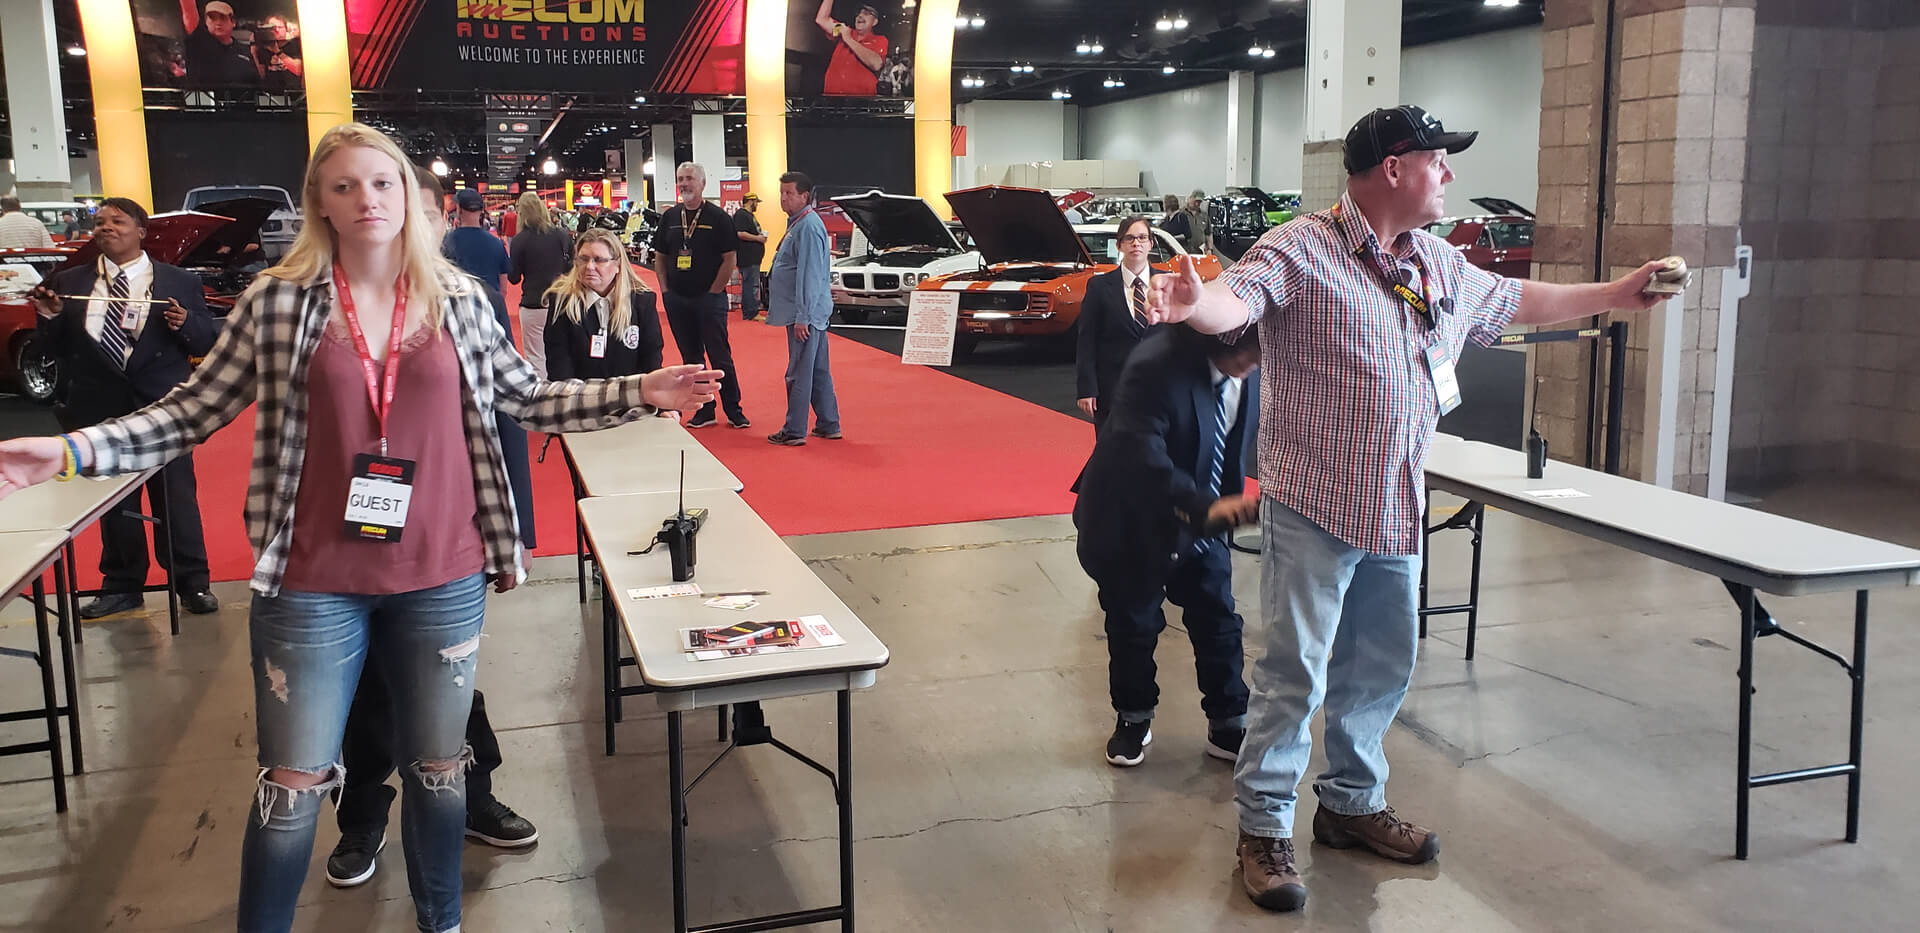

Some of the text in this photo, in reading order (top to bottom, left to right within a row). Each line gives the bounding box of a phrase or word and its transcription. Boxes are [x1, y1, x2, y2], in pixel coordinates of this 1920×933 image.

[456, 0, 645, 23] MECUM
[456, 22, 646, 41] AUCTIONS
[458, 45, 645, 65] WELCOME TO THE EXPERIENCE
[1393, 284, 1428, 314] MECUM
[350, 493, 403, 513] GUEST
